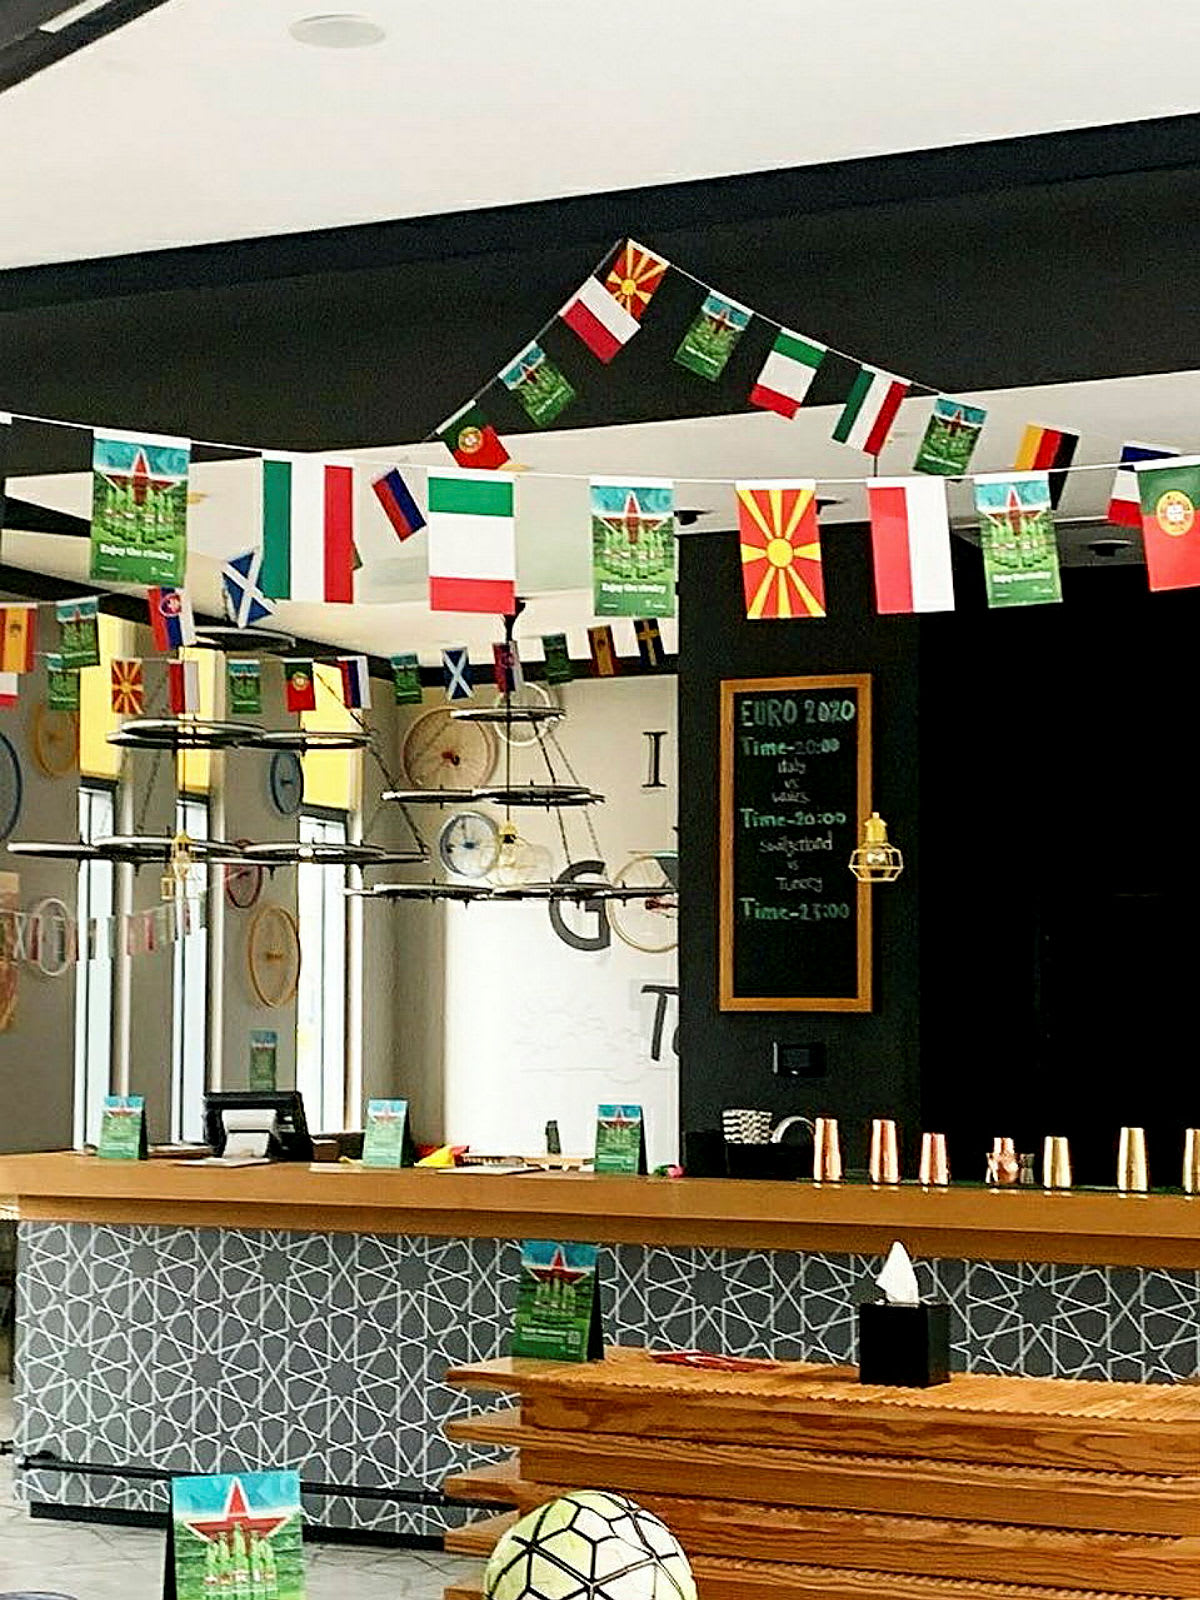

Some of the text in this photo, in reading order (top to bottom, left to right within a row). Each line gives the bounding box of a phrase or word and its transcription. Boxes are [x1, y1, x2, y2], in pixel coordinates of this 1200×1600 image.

[741, 699, 856, 726] EURO 2020
[641, 984, 679, 1062] T
